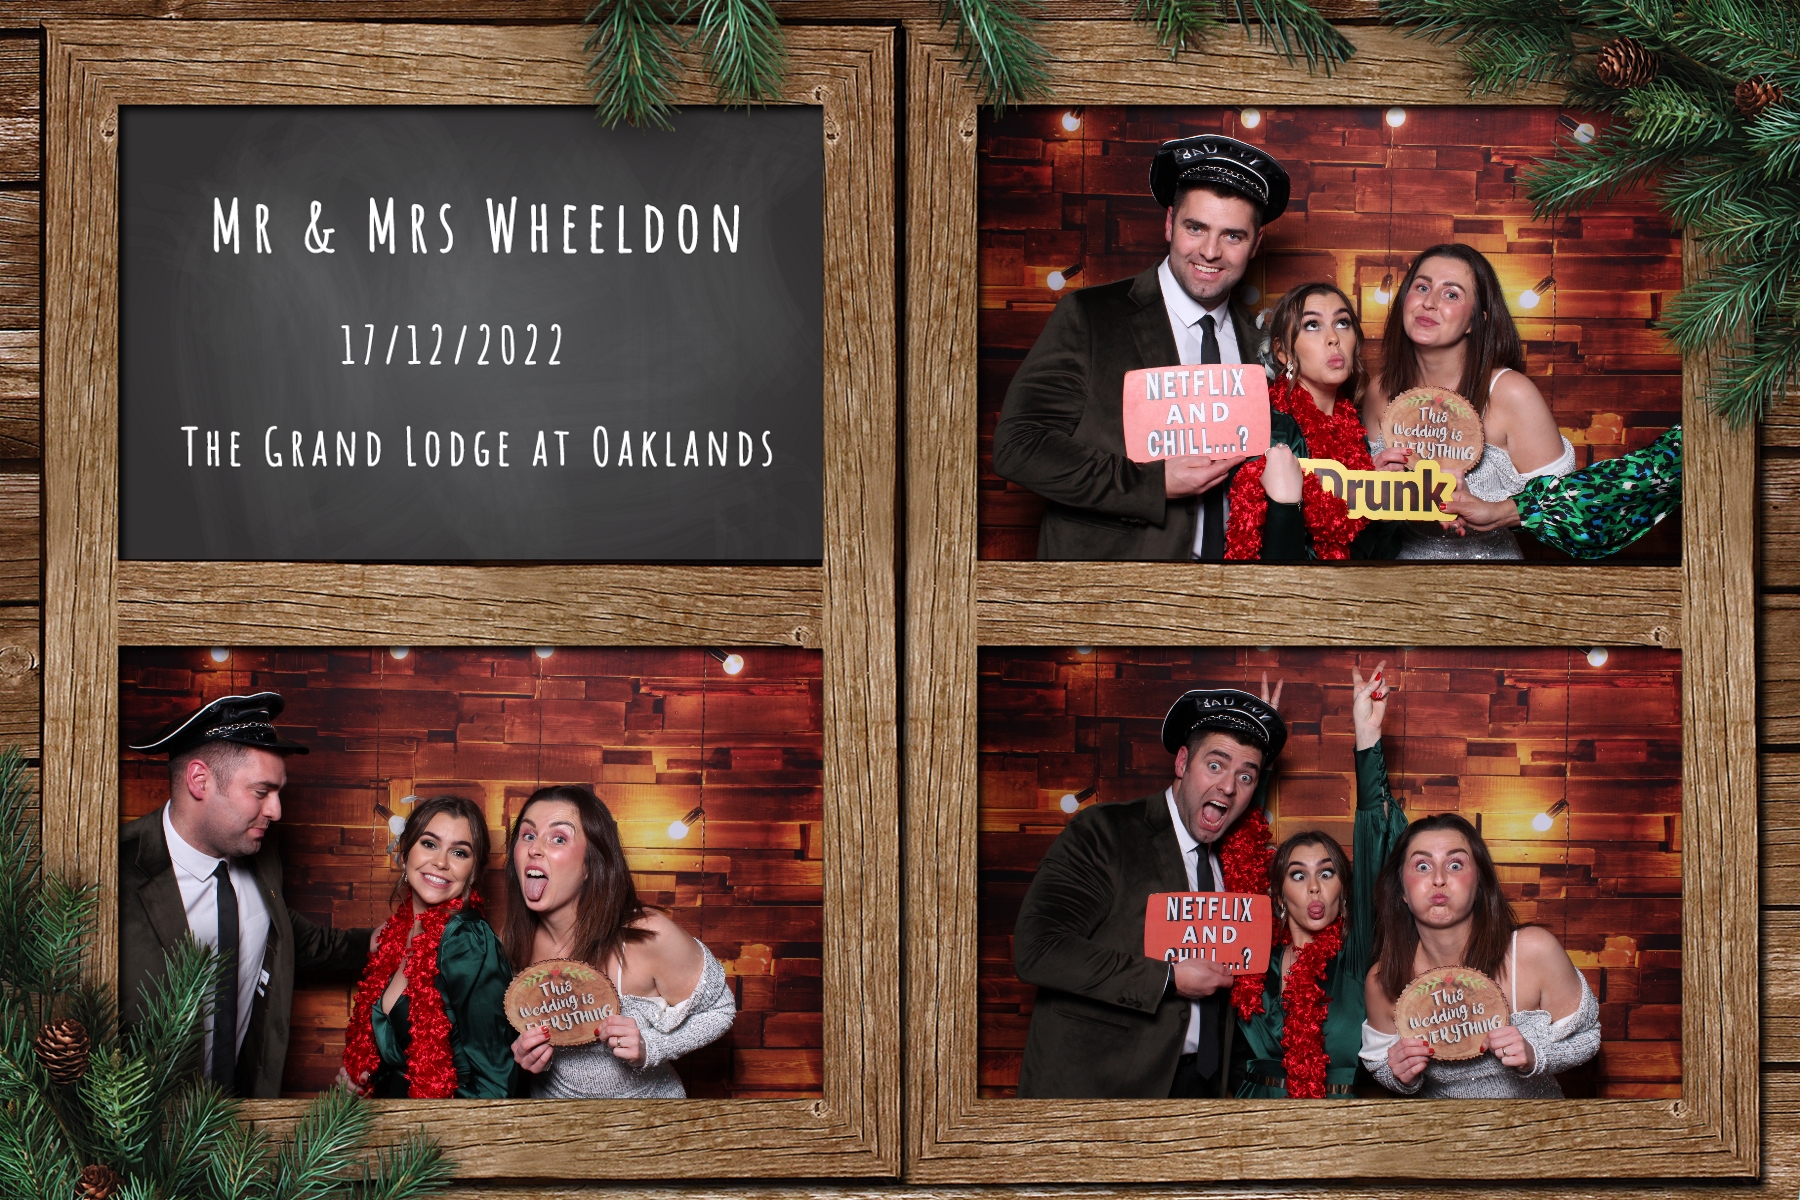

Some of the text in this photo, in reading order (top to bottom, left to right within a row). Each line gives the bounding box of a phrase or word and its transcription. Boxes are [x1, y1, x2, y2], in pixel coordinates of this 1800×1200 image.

[1146, 368, 1246, 400] NETFLIX
[1166, 402, 1230, 424] AND
[1419, 406, 1449, 424] This
[1147, 425, 1249, 457] CHILL...?
[1393, 420, 1463, 442] Wedding is
[1166, 896, 1253, 922] NETFLIX
[1181, 925, 1238, 944] AND
[538, 980, 573, 997] This
[1429, 988, 1464, 1006] This
[518, 993, 595, 1018] Wedding is
[1409, 1002, 1485, 1030] Wedding is
